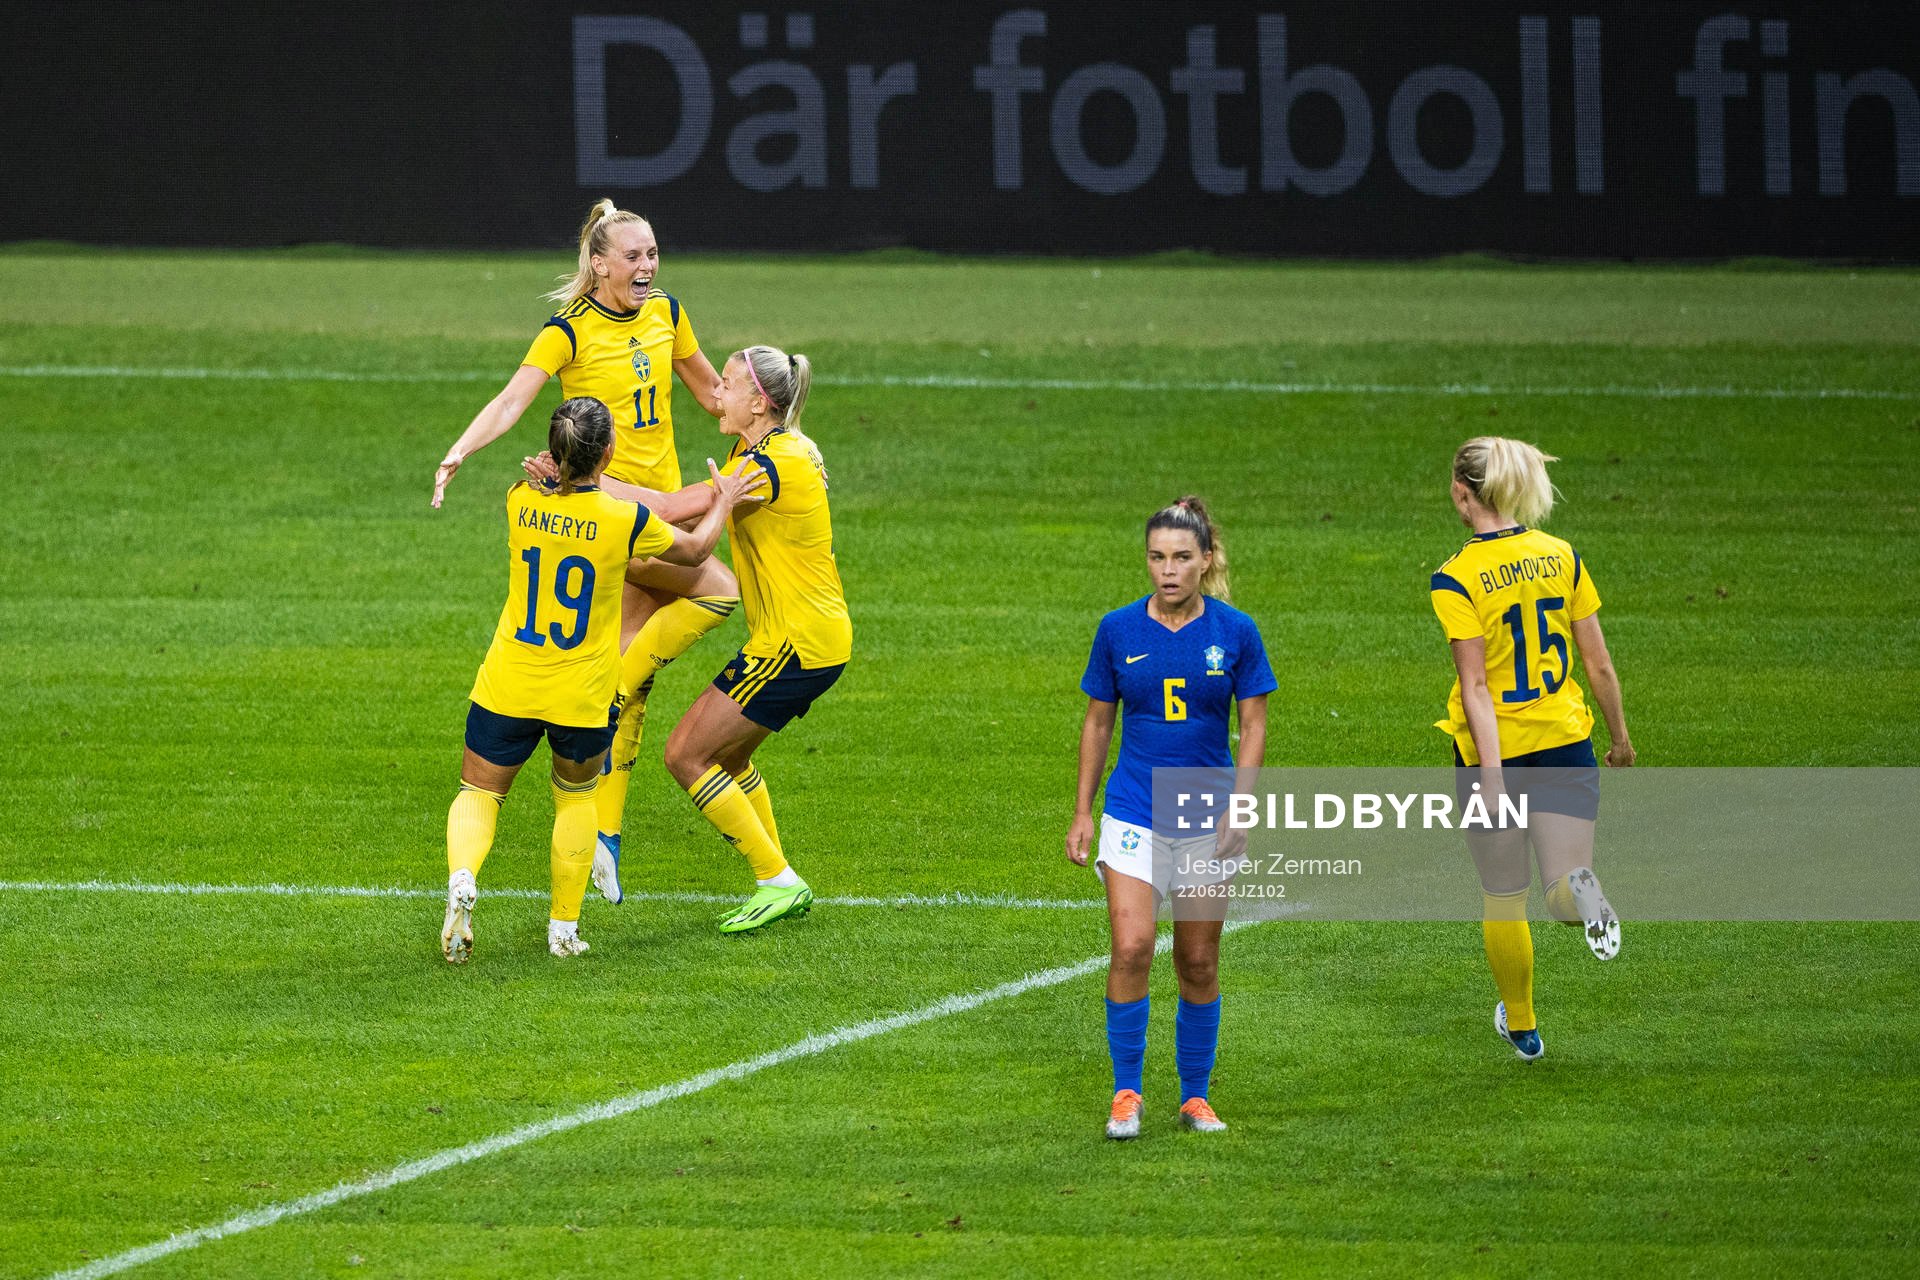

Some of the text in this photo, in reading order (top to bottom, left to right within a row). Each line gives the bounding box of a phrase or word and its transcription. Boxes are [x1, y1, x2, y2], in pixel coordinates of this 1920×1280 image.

[572, 13, 918, 191] Där
[973, 8, 1604, 196] fotboll
[633, 385, 660, 430] 11
[518, 506, 598, 542] KANERYD
[1479, 555, 1563, 595] BLOMQVIST
[514, 546, 596, 650] 19
[1502, 596, 1569, 703] 15
[1163, 678, 1187, 721] 6
